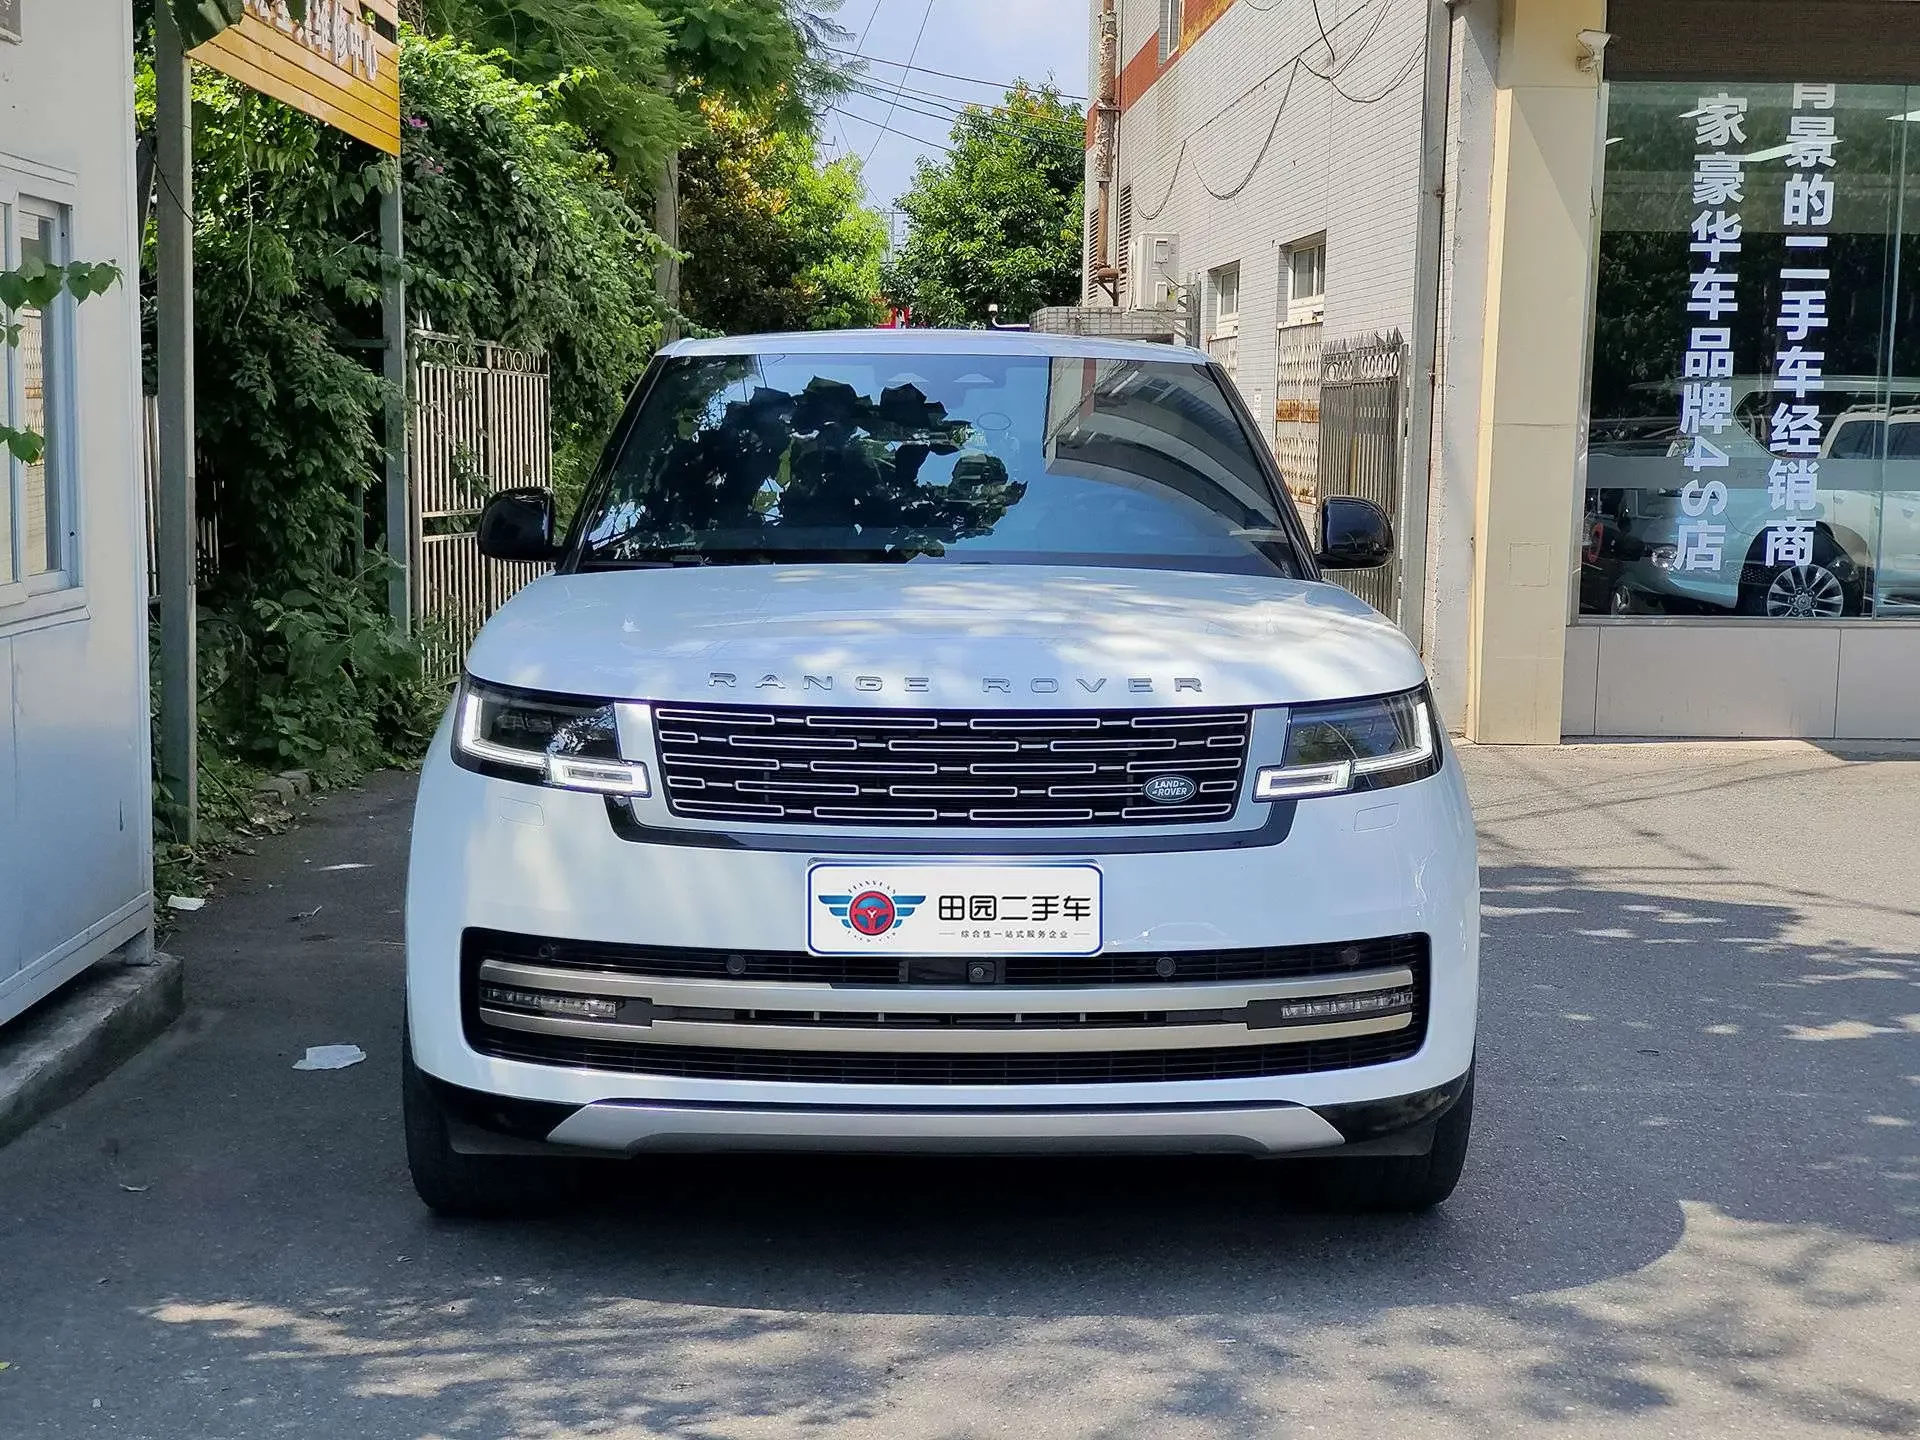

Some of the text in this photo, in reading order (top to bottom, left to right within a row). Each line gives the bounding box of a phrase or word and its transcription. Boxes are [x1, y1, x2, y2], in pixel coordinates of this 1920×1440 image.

[1673, 93, 1747, 570] 家豪华车品牌4S店
[708, 672, 1203, 693] RANGE ROVER
[1155, 780, 1179, 788] LAND
[1157, 787, 1187, 796] ROVER
[939, 895, 1091, 921] 田园二手车
[961, 930, 1068, 939] 综合性一站式服务企业
